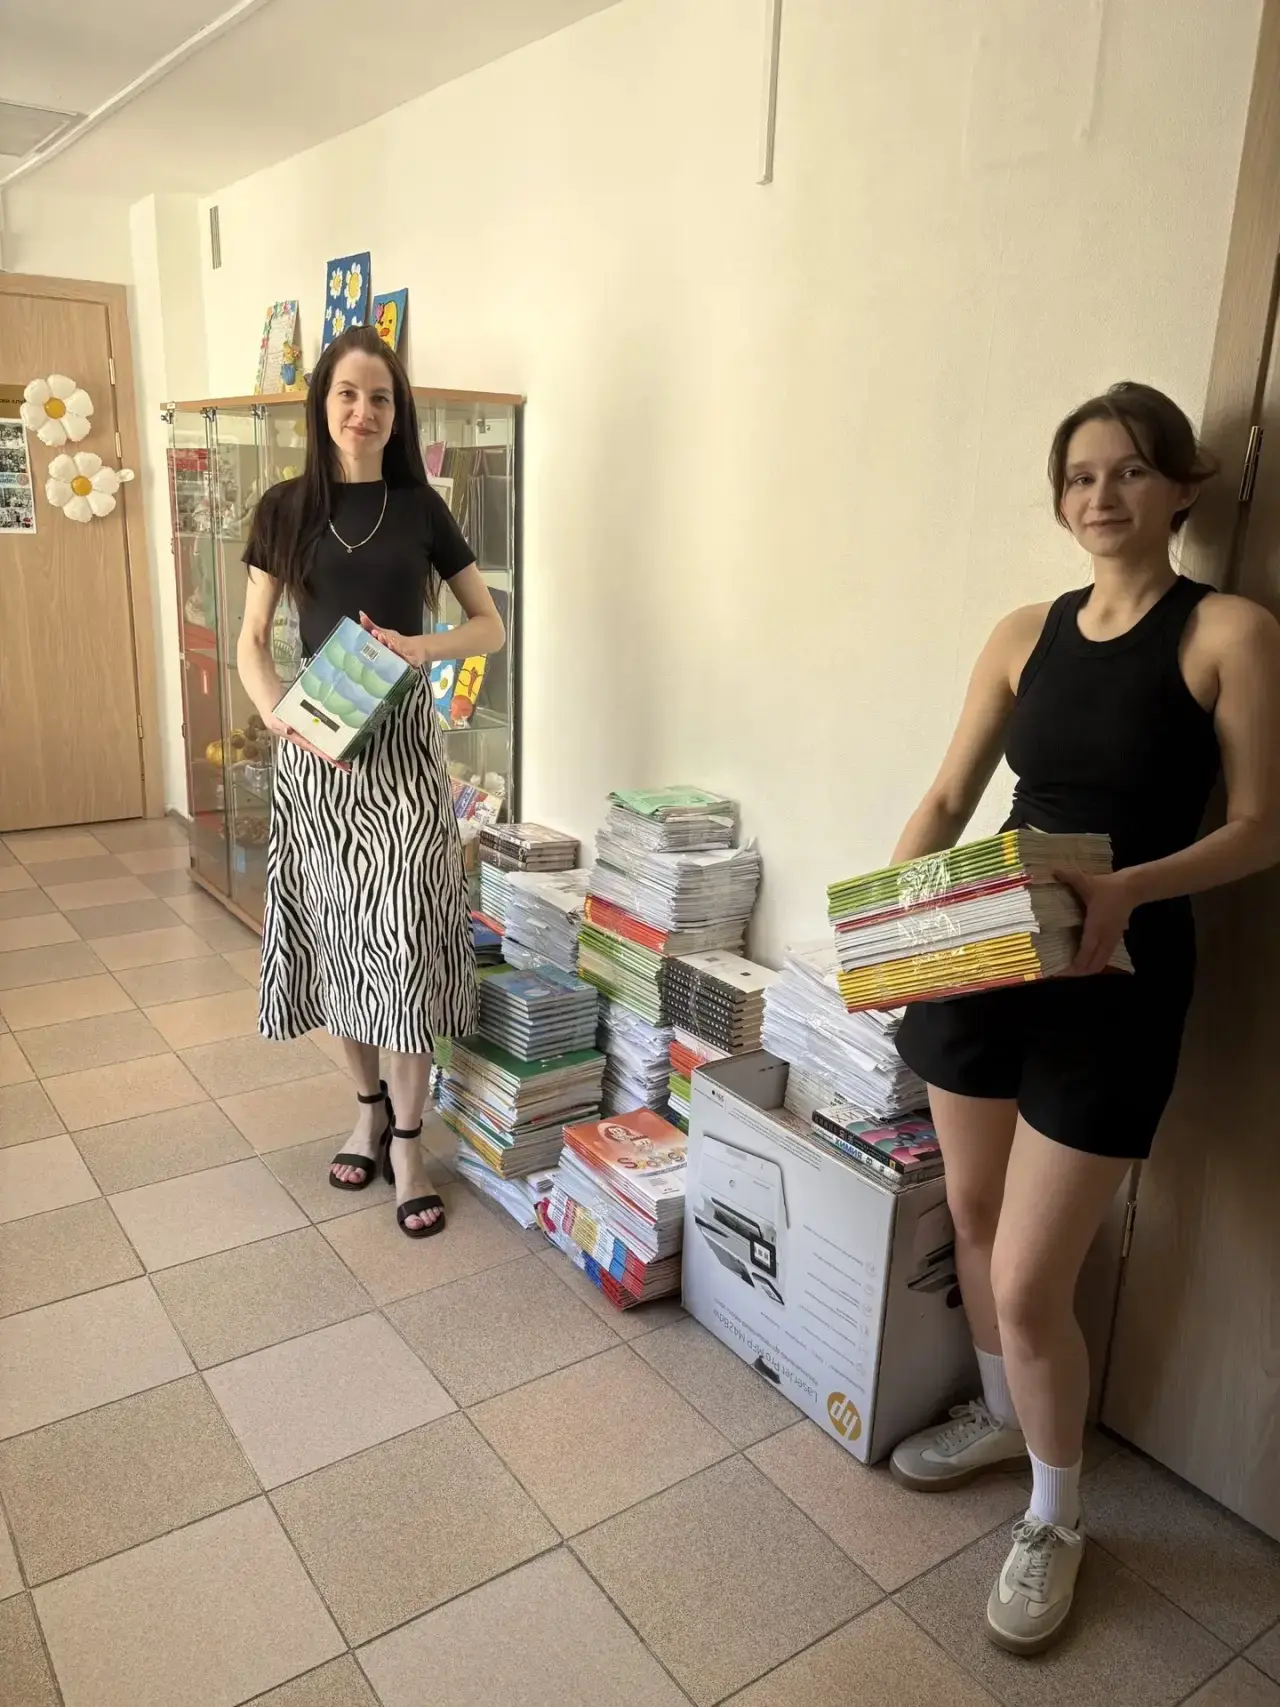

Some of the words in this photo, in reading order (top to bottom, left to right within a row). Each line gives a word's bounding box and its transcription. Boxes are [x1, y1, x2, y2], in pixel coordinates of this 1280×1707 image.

[835, 1138, 863, 1161] ХИМИЯ
[747, 1336, 764, 1358] MFP
[765, 1350, 780, 1373] Pro
[781, 1363, 818, 1403] LaserJet
[829, 1395, 858, 1441] hp
